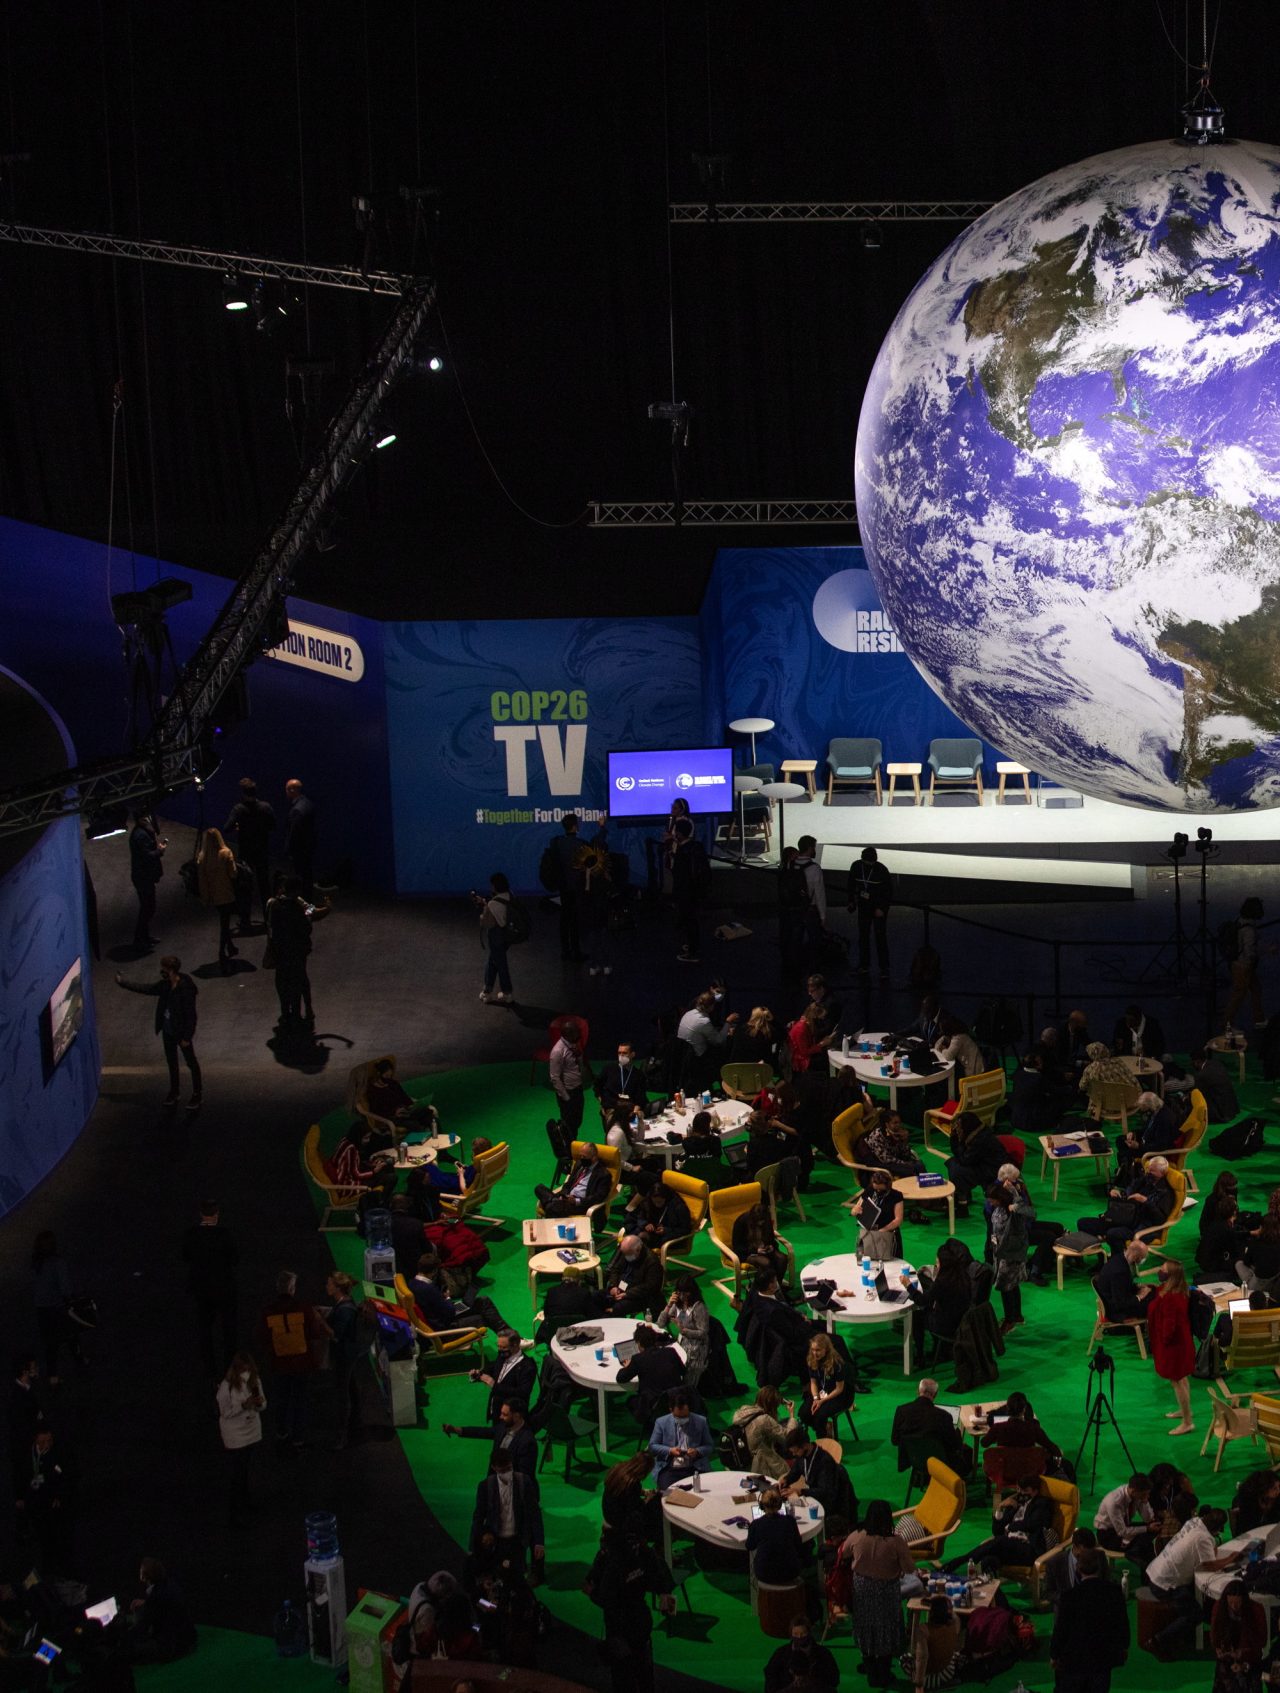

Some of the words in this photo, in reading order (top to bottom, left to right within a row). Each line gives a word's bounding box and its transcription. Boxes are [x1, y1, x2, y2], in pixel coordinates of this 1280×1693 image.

[308, 636, 342, 668] ROOM
[344, 646, 353, 672] 2
[857, 631, 905, 653] RESIL
[490, 689, 589, 722] COP26
[493, 724, 588, 797] TV
